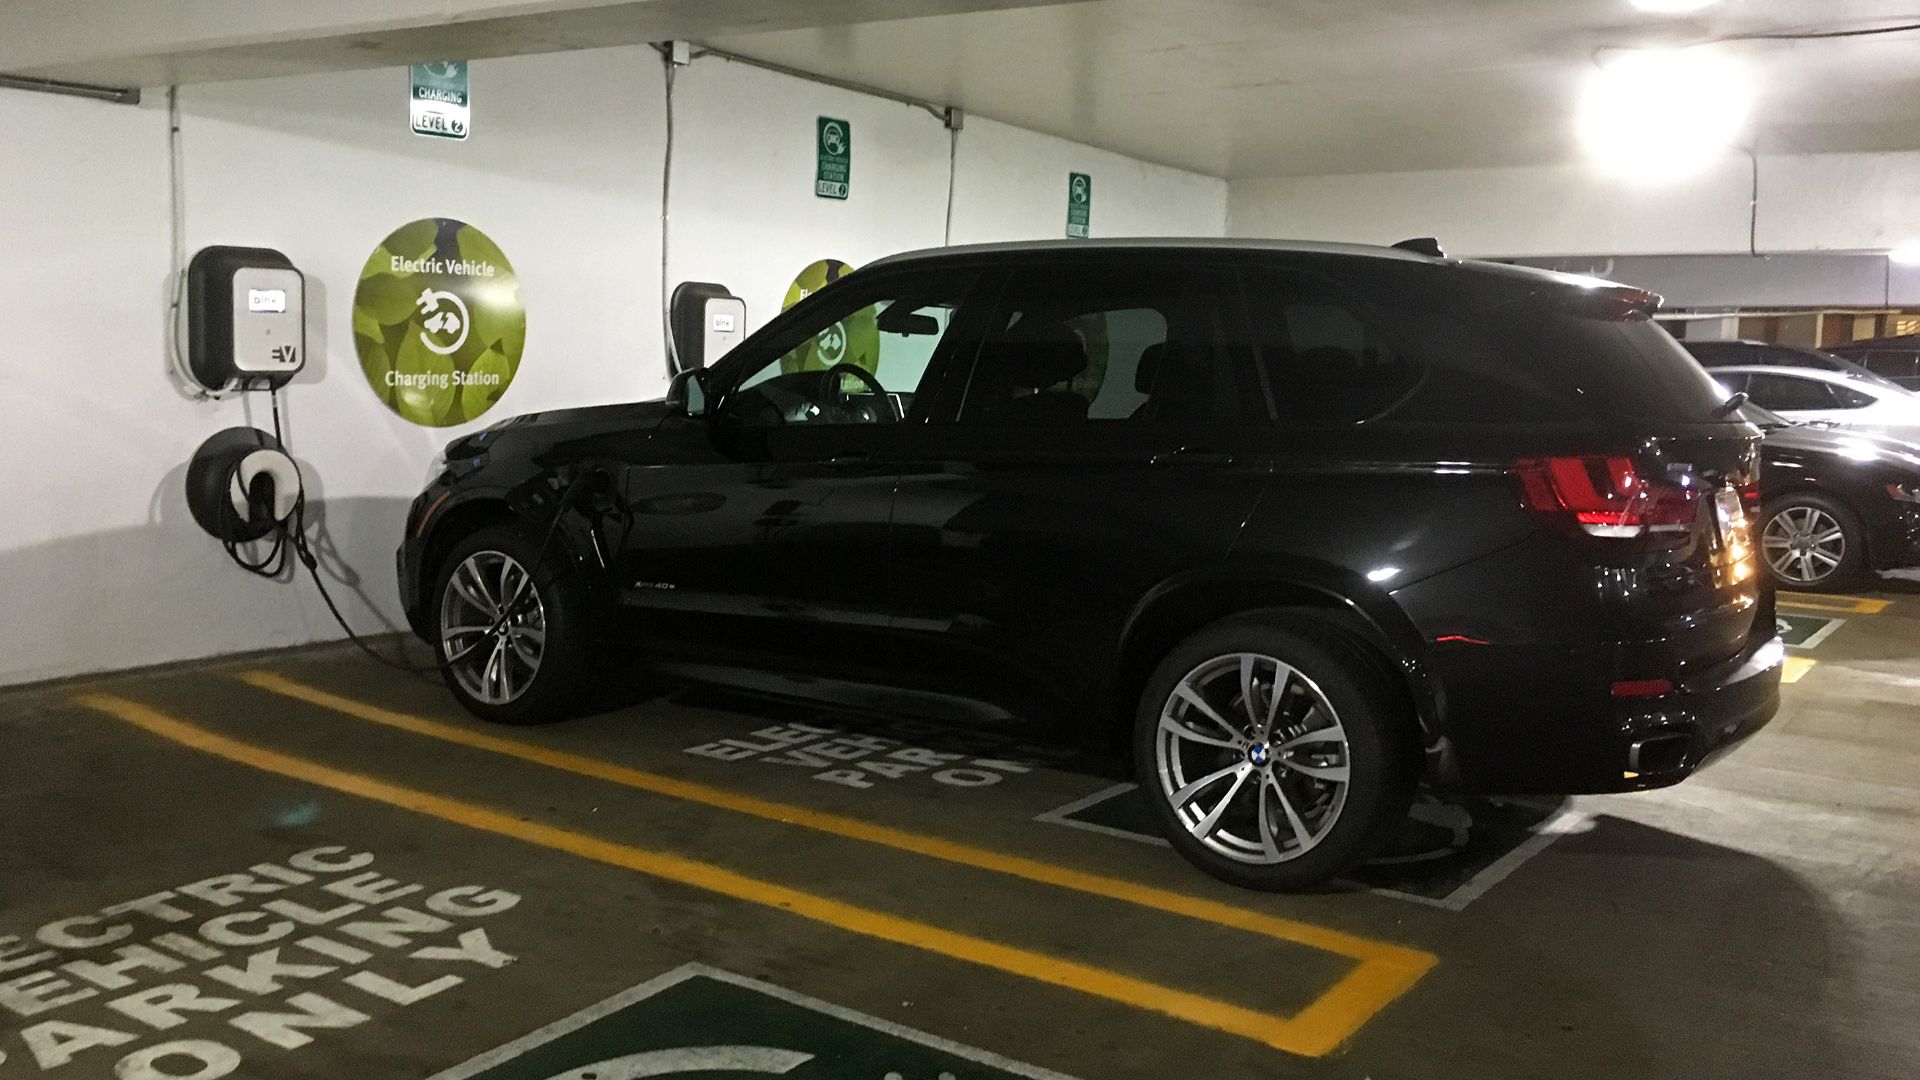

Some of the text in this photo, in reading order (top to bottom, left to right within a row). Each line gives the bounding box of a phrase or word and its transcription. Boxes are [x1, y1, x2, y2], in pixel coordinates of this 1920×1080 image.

[418, 86, 463, 104] CHARGING
[415, 115, 463, 133] LEVEL 2
[818, 182, 837, 195] LEVEL
[391, 256, 495, 277] Electric Vehicle
[385, 370, 500, 389] Charging Station
[0, 885, 522, 1071] ARKING
[112, 927, 519, 1080] ONLY
